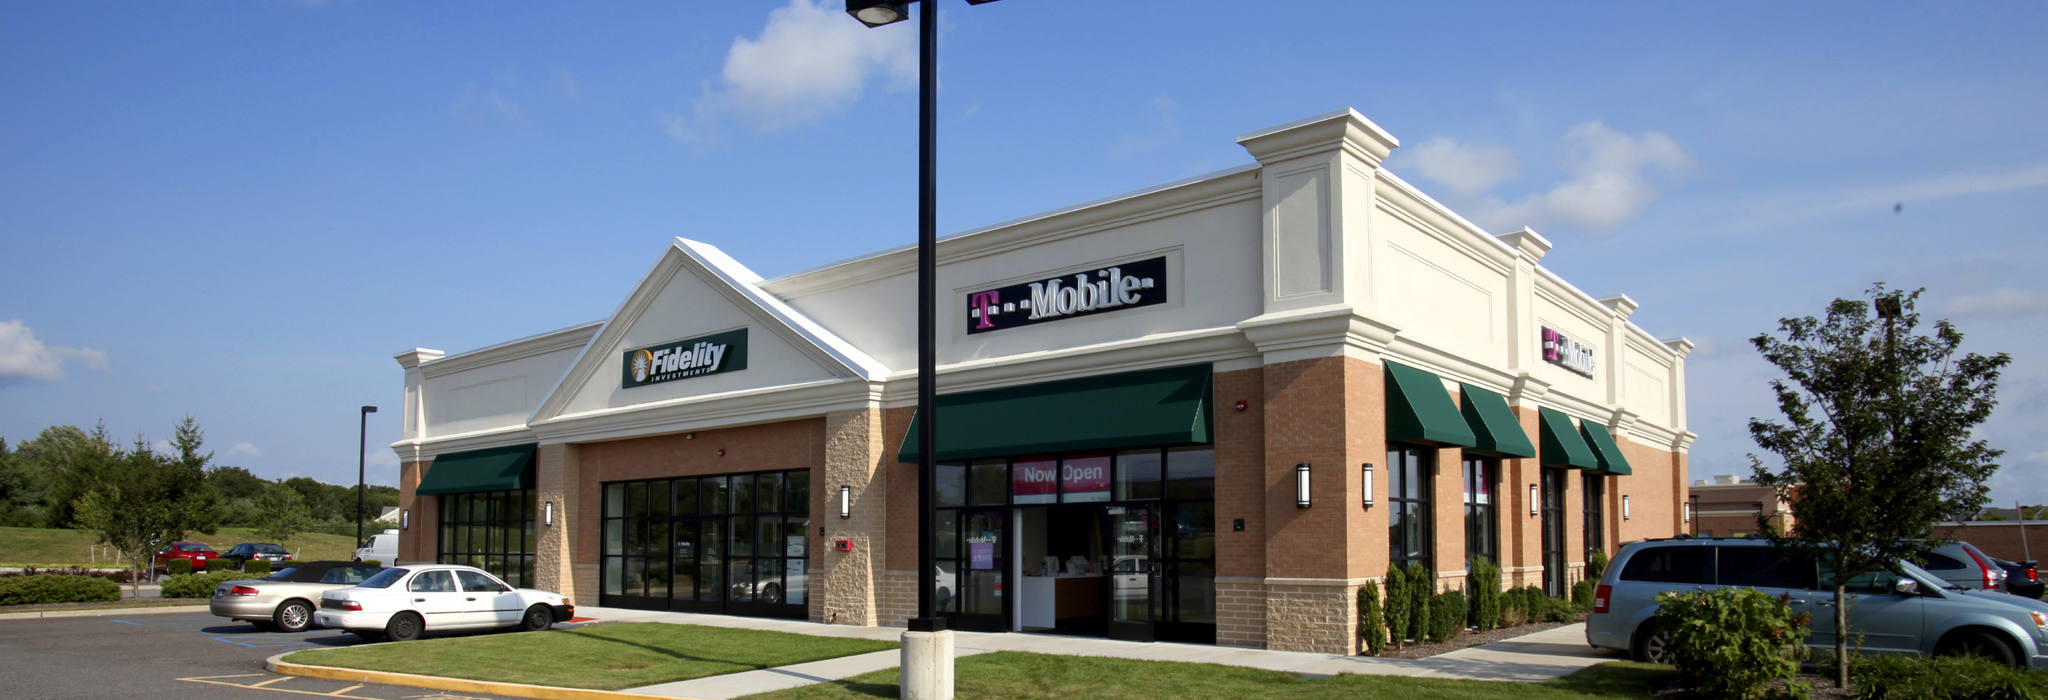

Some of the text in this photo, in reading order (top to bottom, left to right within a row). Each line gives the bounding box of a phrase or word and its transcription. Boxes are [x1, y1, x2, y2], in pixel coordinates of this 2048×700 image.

[650, 341, 726, 374] Fidelity
[651, 367, 712, 382] INVESTMENTS
[1024, 464, 1103, 483] Now Open
